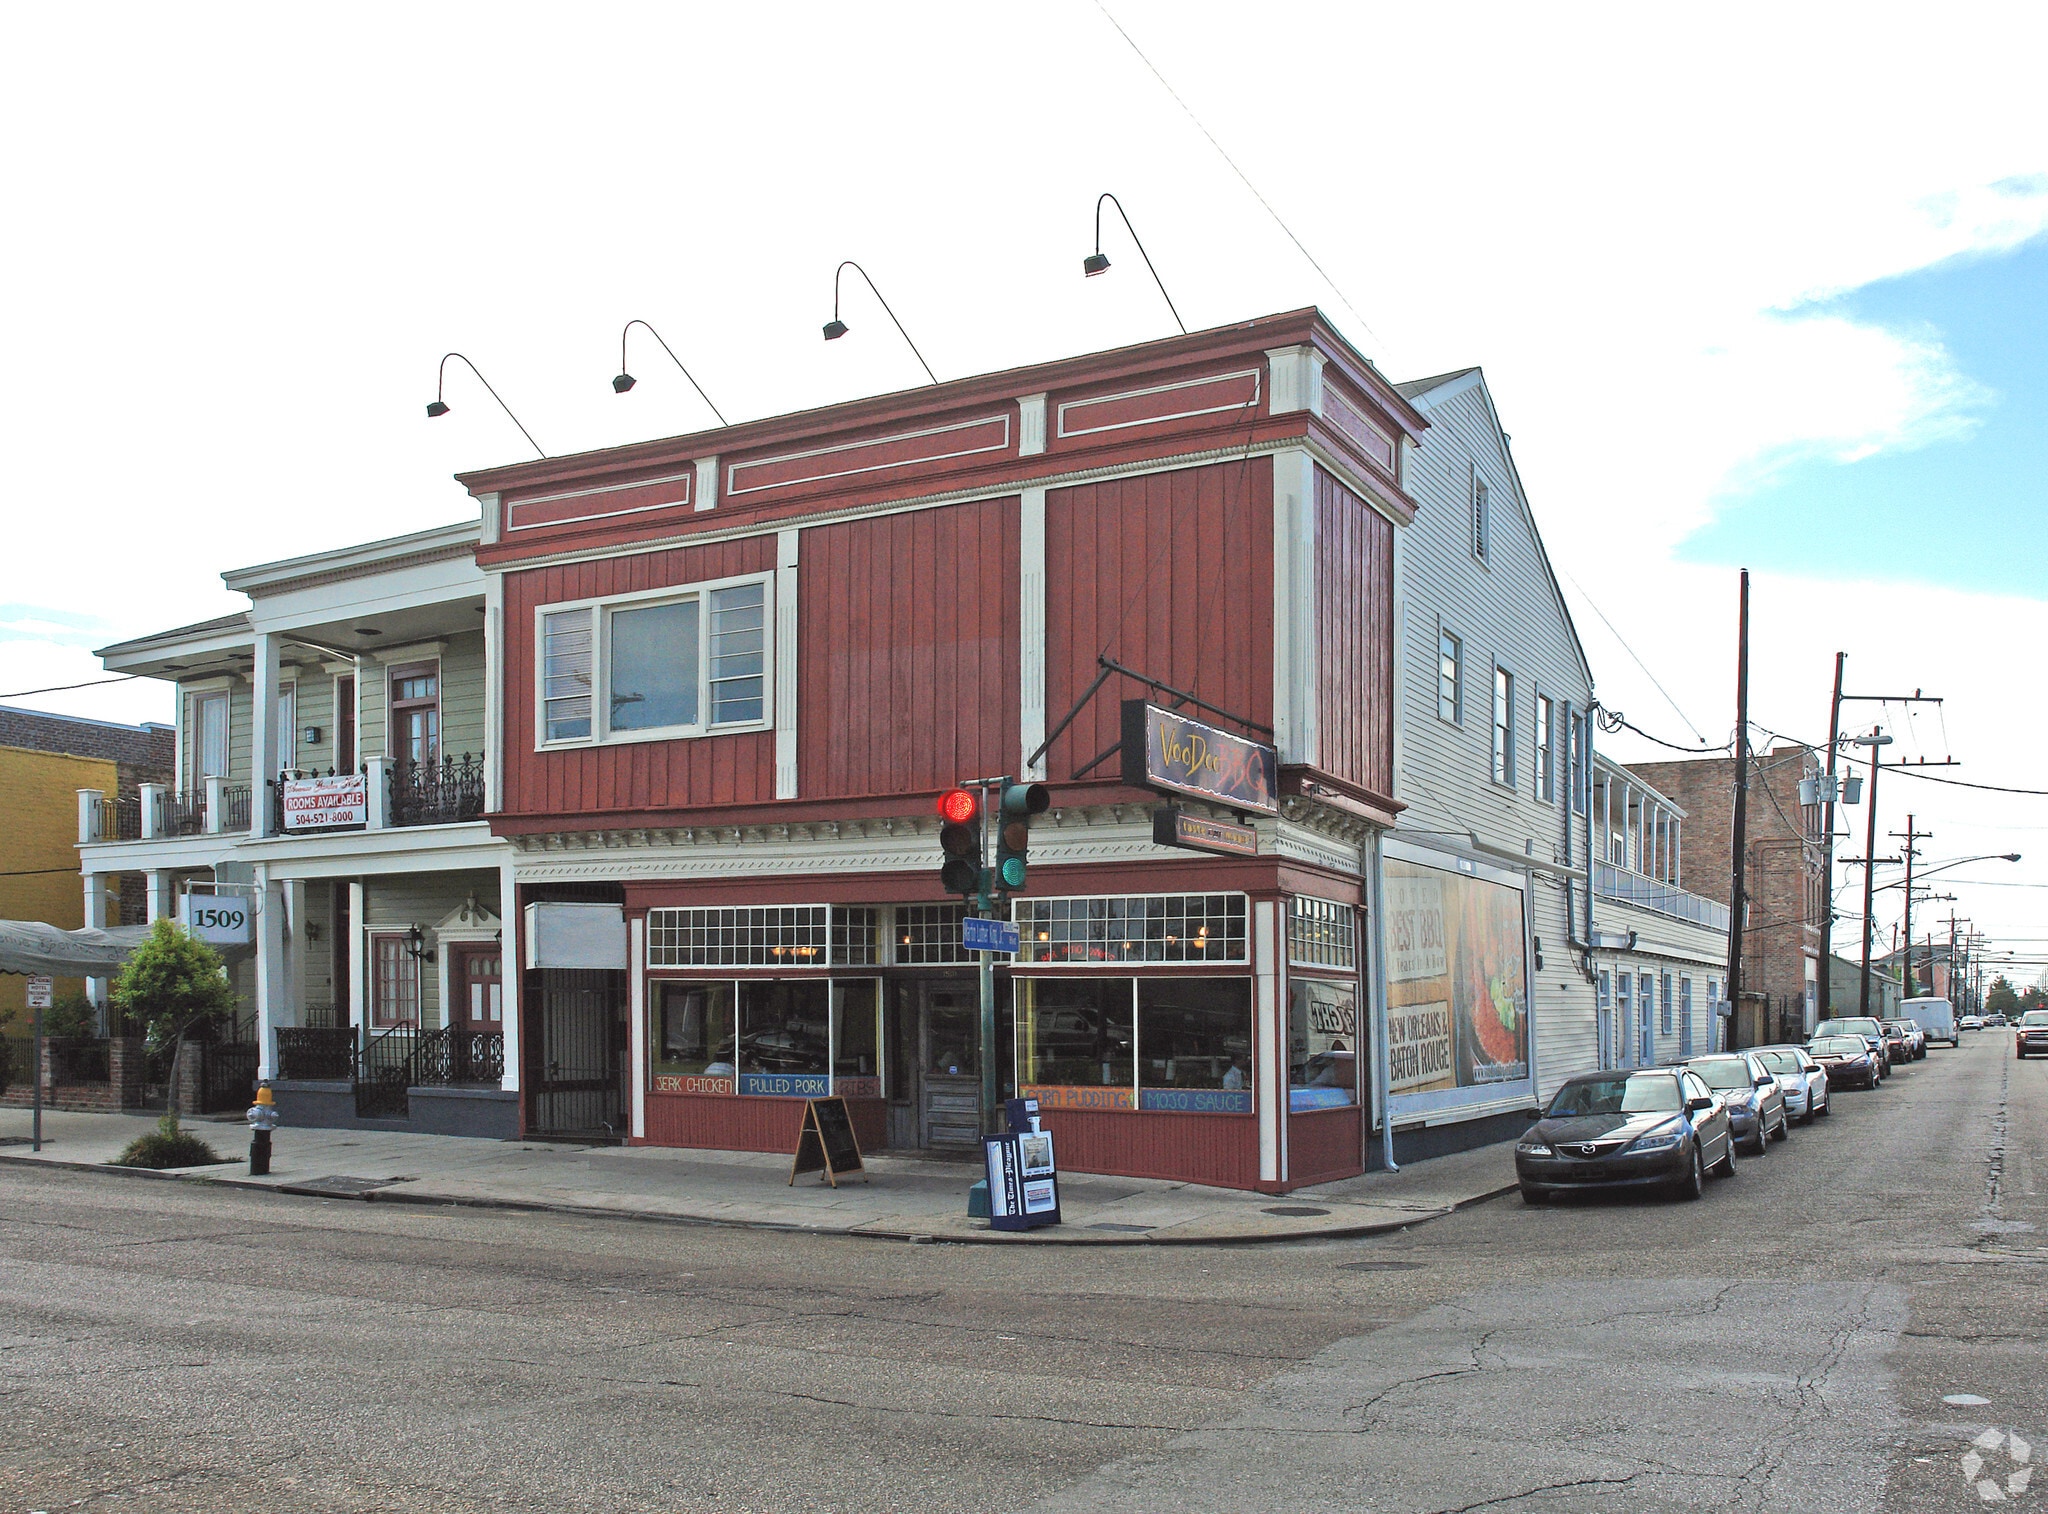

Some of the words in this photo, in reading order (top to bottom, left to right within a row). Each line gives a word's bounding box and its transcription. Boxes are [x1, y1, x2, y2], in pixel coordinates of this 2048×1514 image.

[1216, 744, 1268, 797] BBQ
[288, 797, 316, 811] ROOMS
[317, 793, 361, 808] AVAILABLE
[295, 810, 354, 825] 504-521-8000
[194, 909, 245, 930] 1509
[1389, 909, 1416, 952] BEST
[1419, 908, 1443, 950] BBQ
[1061, 944, 1083, 956] PAIO
[1388, 1016, 1406, 1045] NEW
[1407, 1011, 1441, 1041] ORLEANS
[1441, 1011, 1448, 1036] &
[1390, 1043, 1419, 1081] BATON
[1420, 1038, 1450, 1075] ROUGE
[656, 1076, 682, 1091] JERK
[686, 1077, 732, 1093] CHICKEN
[750, 1078, 790, 1093] PULLED
[795, 1078, 826, 1094] PORK
[1065, 1090, 1127, 1108] PUDDING
[1146, 1092, 1187, 1110] MOJO
[1195, 1094, 1243, 1112] SAUCE
[1008, 1200, 1016, 1215] The
